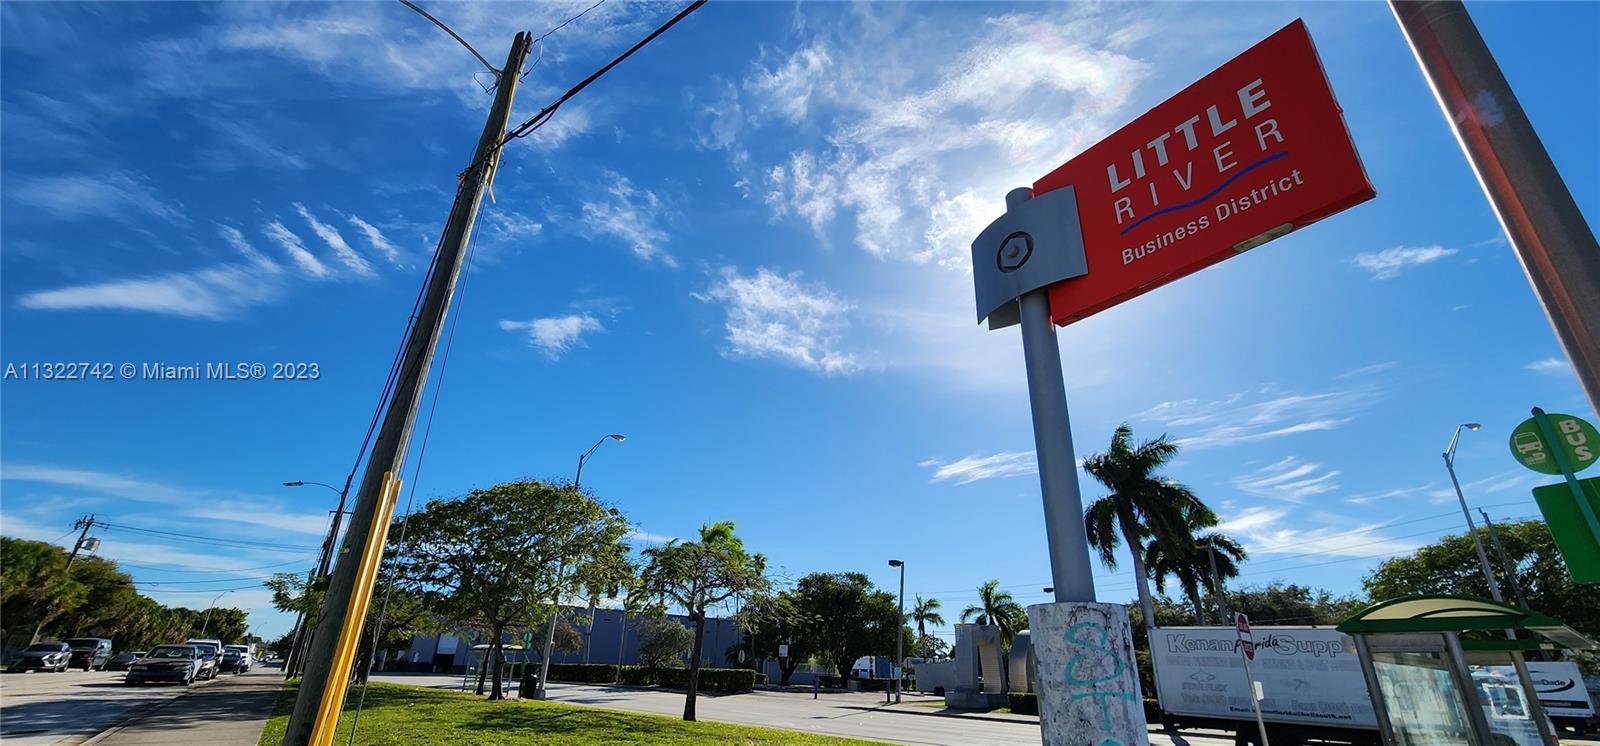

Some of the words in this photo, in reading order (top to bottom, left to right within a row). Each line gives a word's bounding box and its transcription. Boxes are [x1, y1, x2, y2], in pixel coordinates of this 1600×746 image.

[1106, 77, 1271, 193] LITTLE
[1113, 119, 1285, 225] RIVER
[1121, 216, 1210, 265] Business
[1215, 169, 1304, 222] District
[1558, 419, 1593, 462] BUS
[1167, 633, 1233, 653] Kenan
[1234, 634, 1279, 654] Frida
[1273, 634, 1345, 657] Supp
